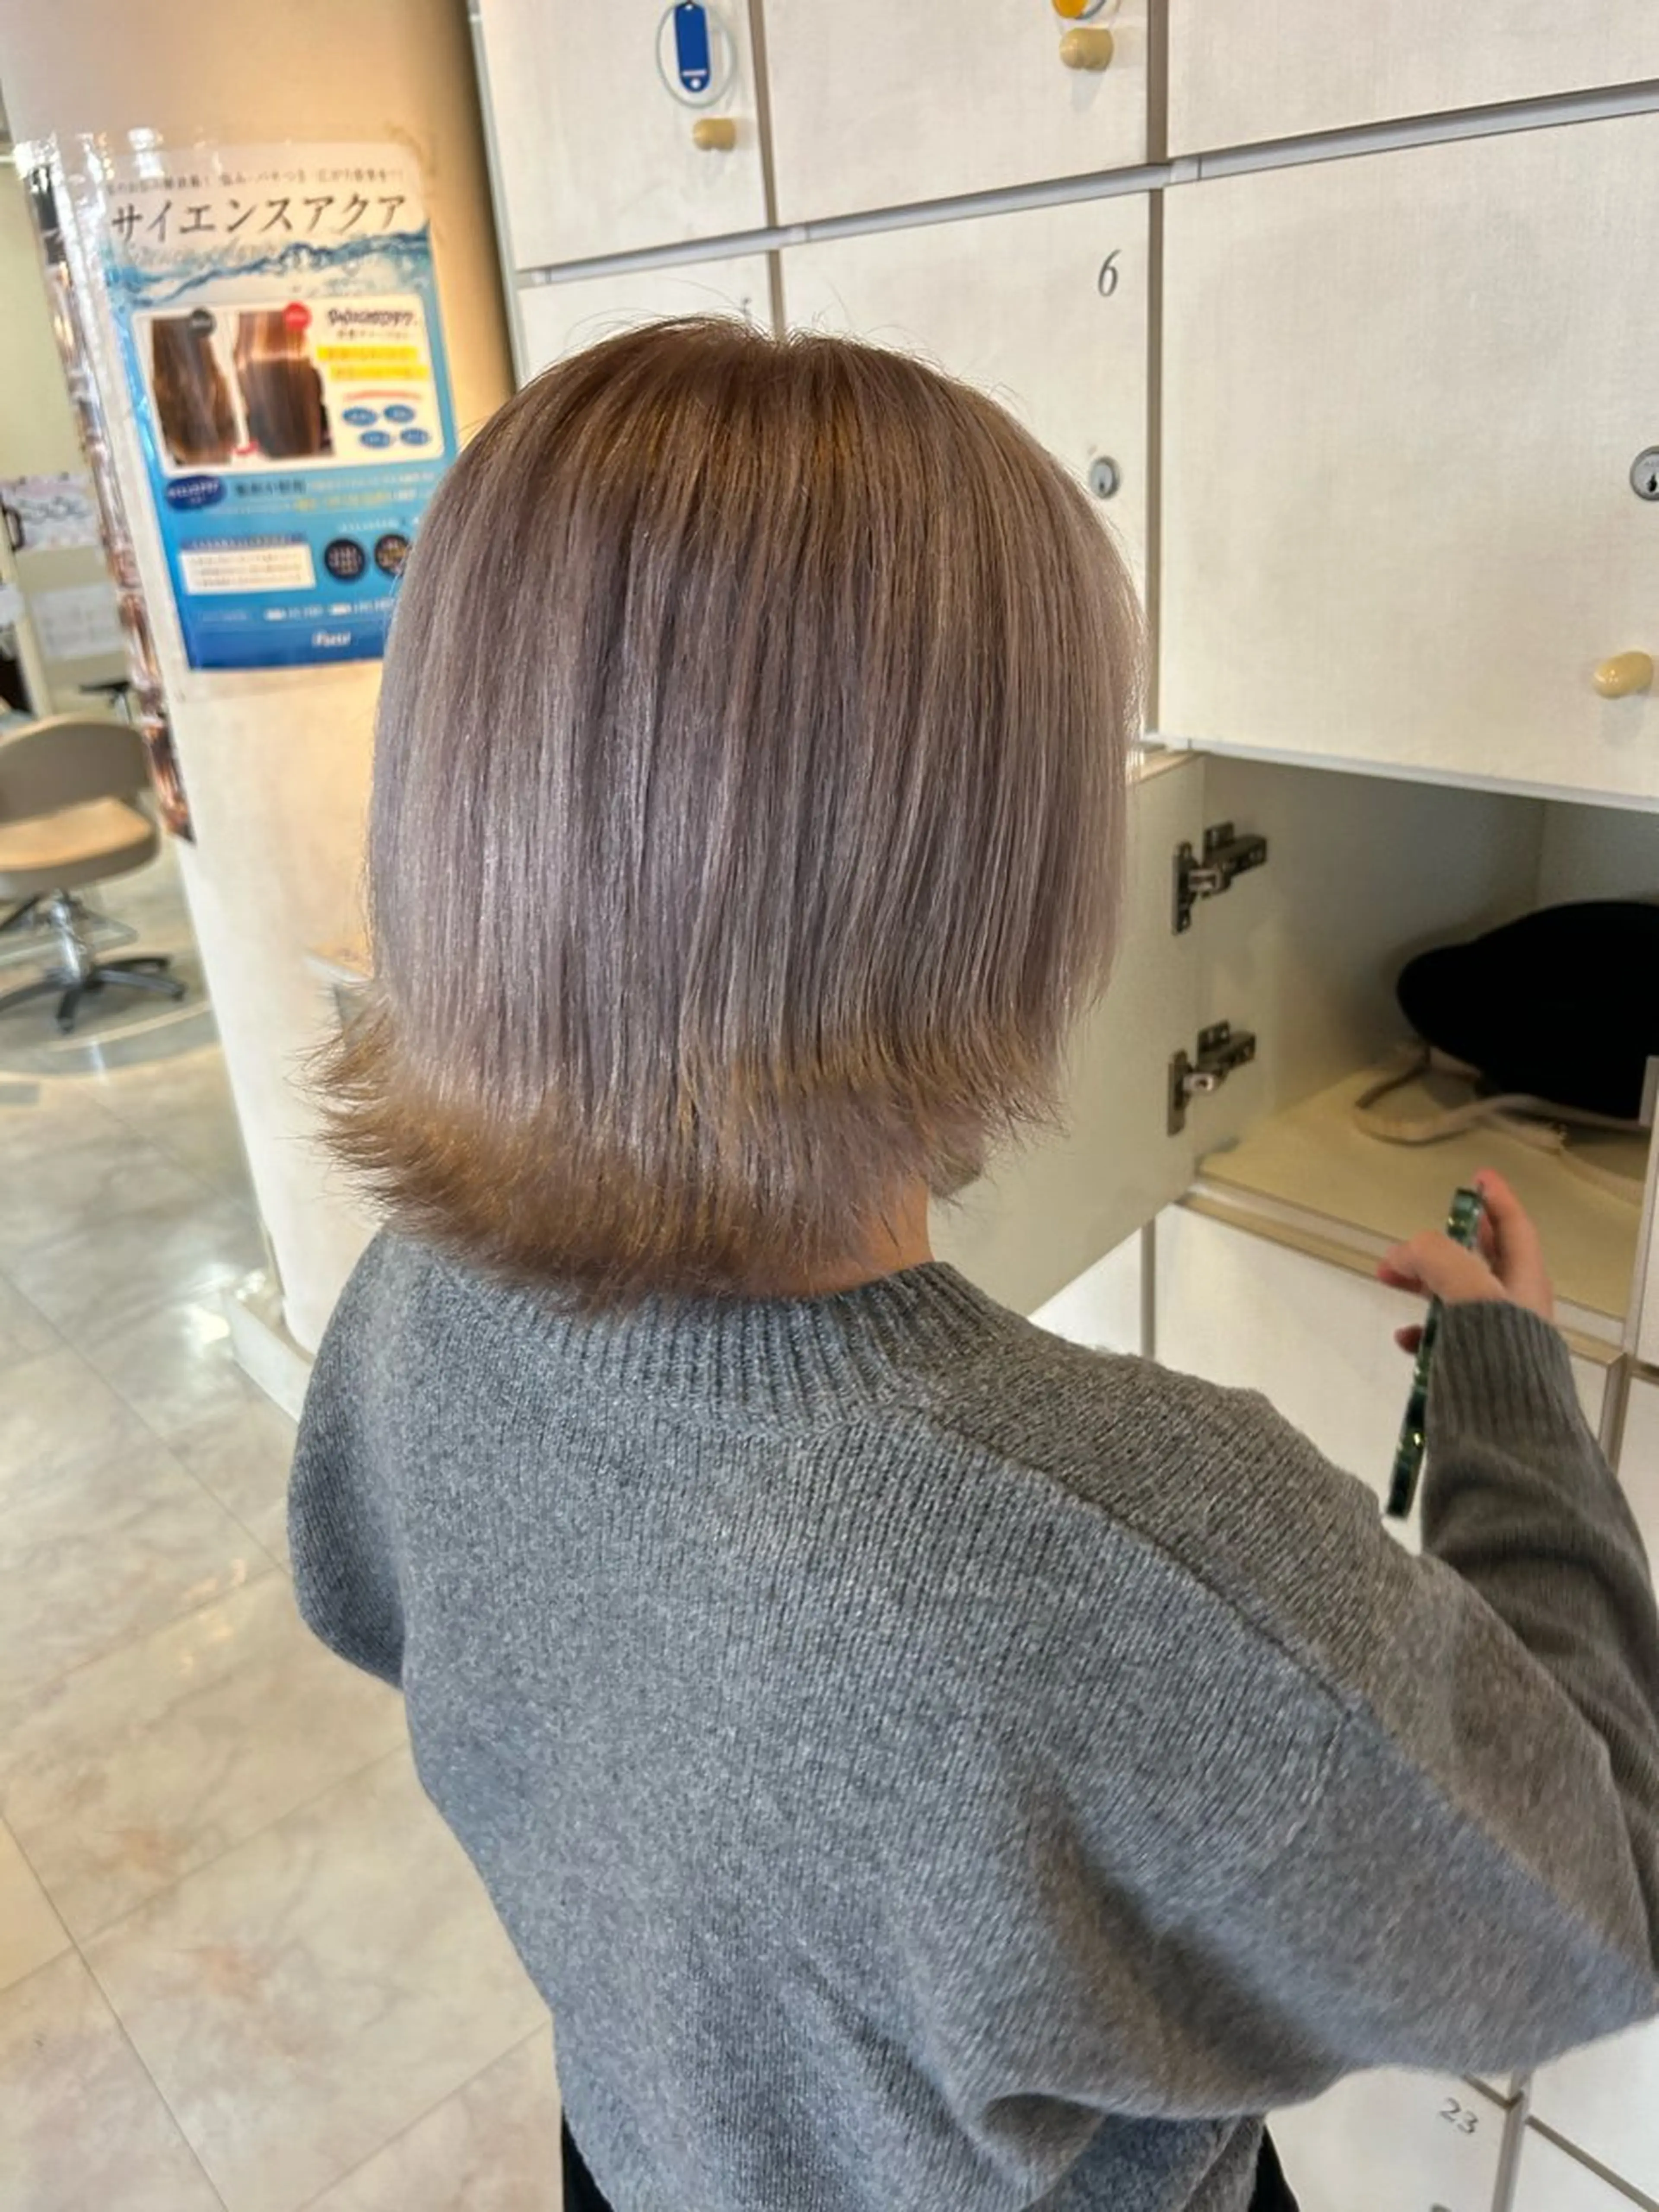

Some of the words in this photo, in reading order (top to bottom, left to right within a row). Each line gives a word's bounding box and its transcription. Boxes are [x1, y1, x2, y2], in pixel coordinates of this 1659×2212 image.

[111, 193, 405, 242] サイエンスアクア
[1098, 249, 1122, 297] 6
[1439, 2098, 1478, 2134] 23
